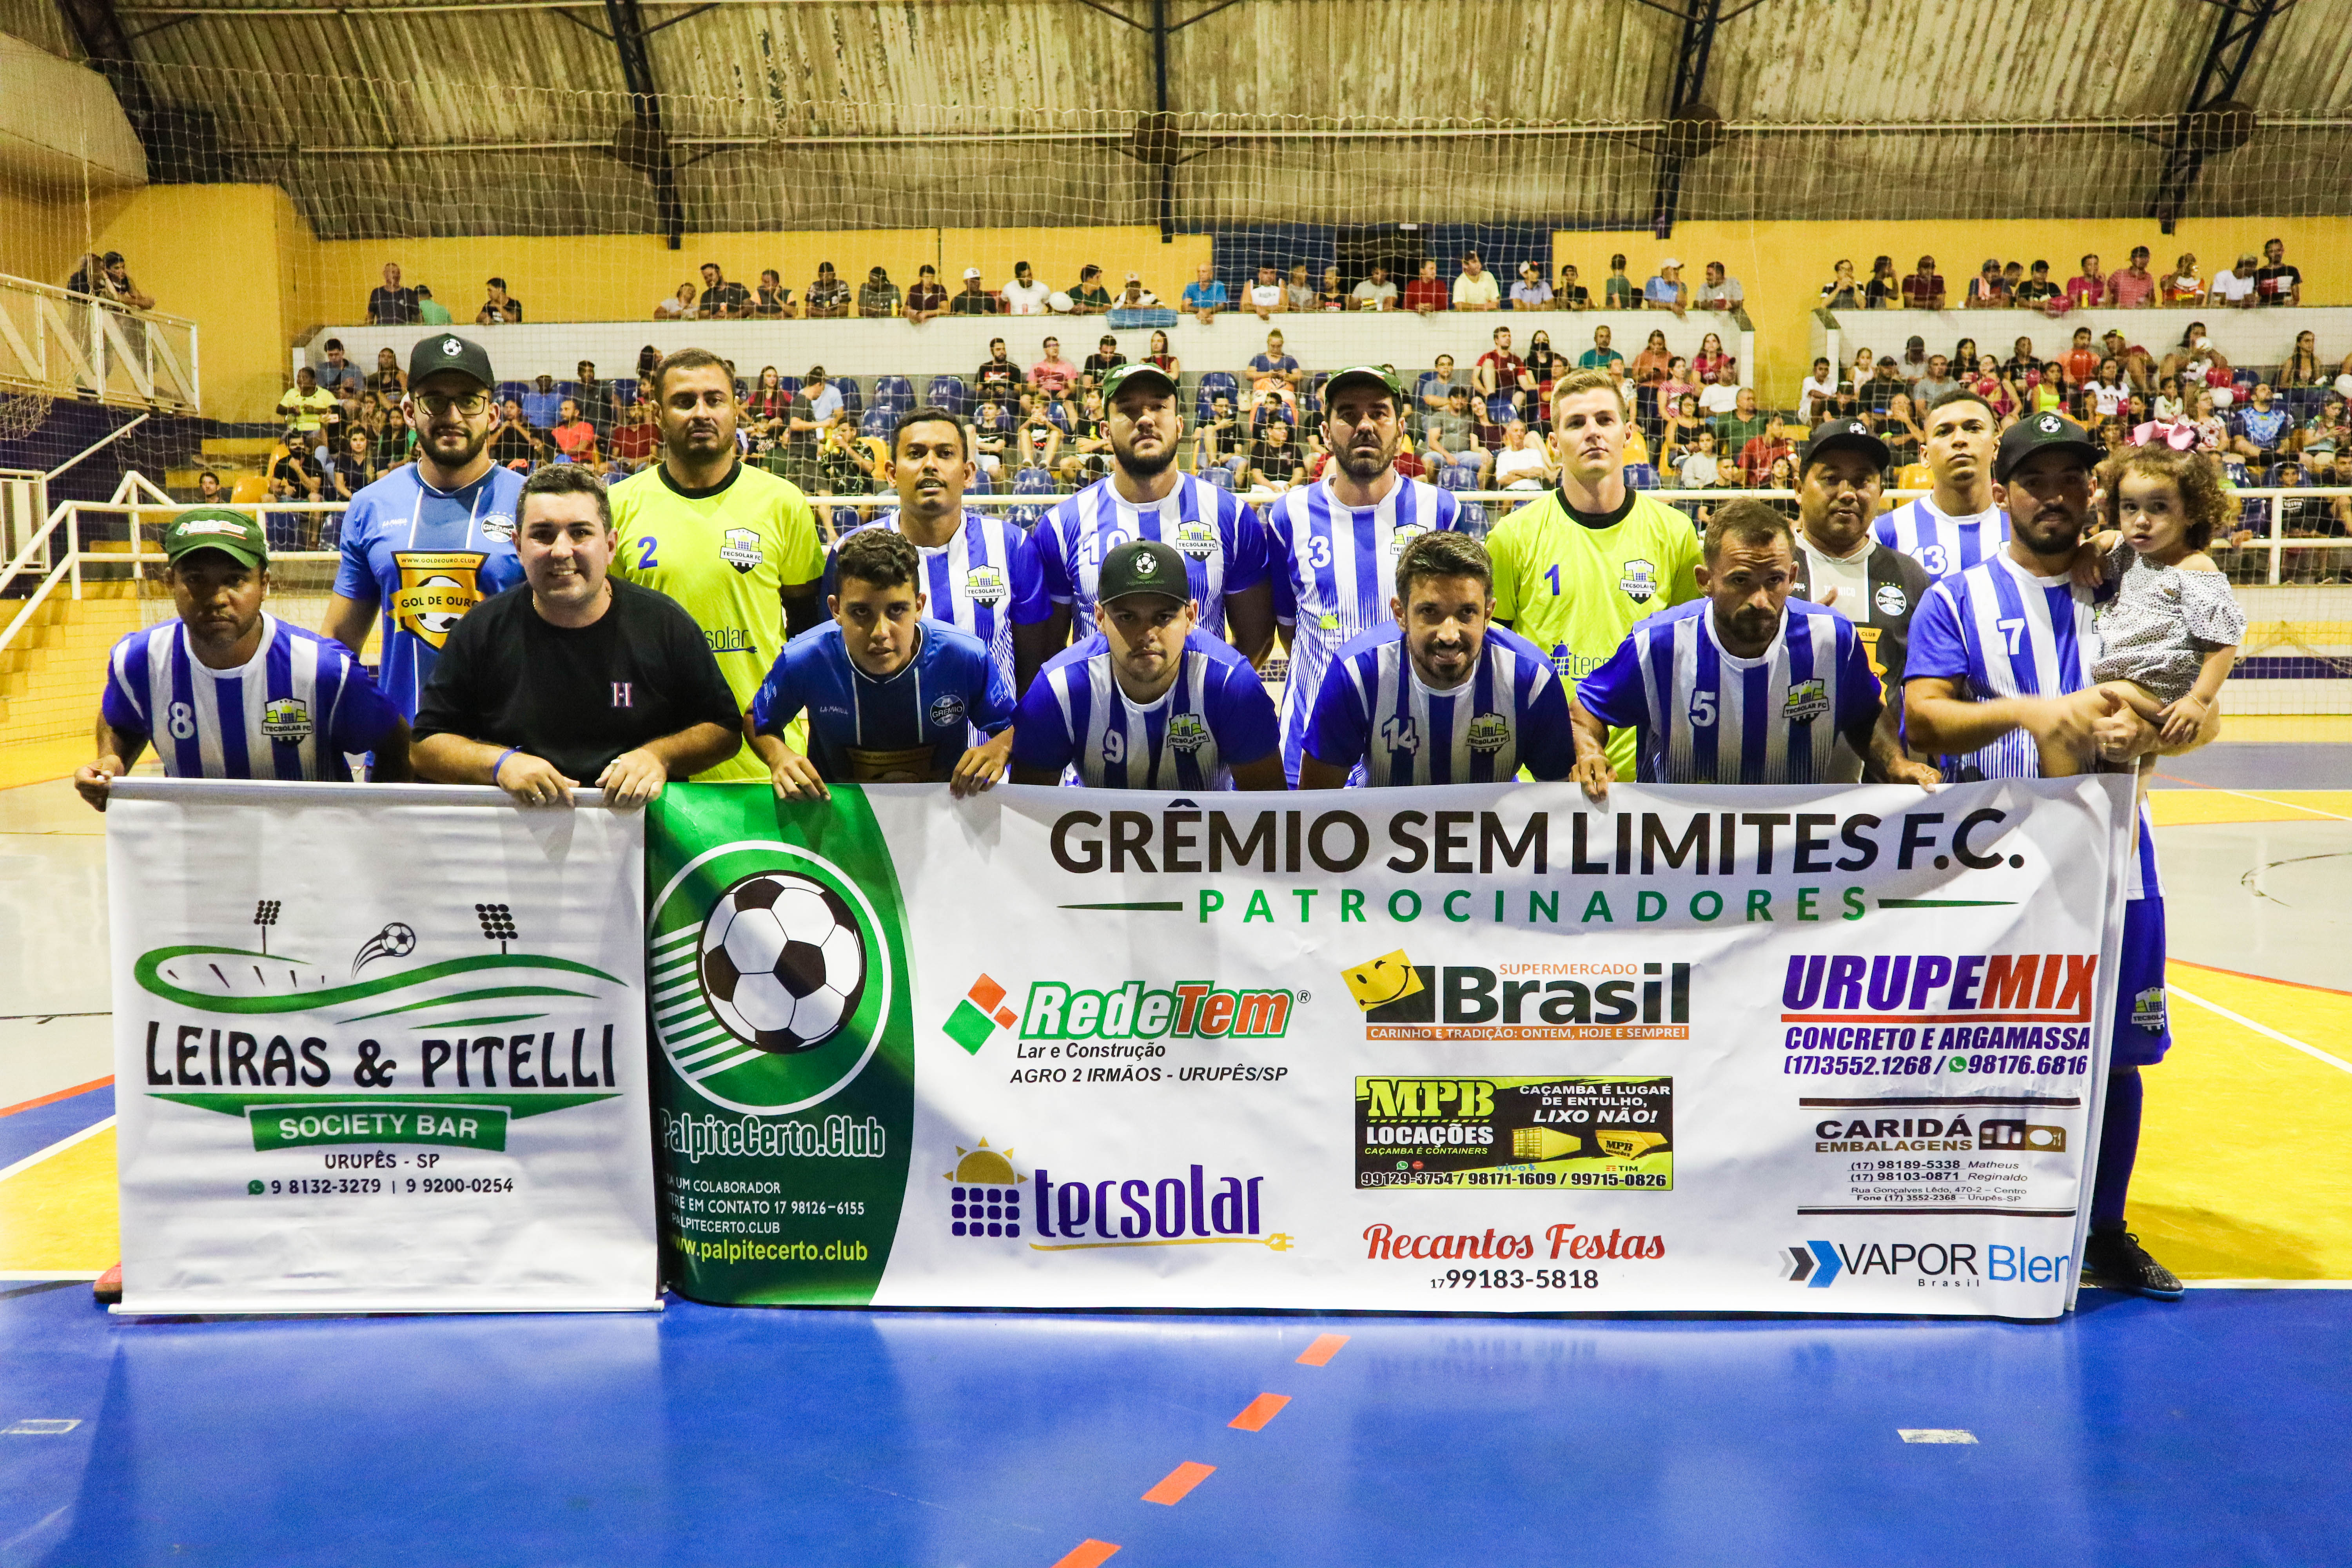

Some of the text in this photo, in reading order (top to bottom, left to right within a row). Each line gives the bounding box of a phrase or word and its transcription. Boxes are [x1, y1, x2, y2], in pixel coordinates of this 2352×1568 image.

[637, 536, 658, 570] 2
[1308, 535, 1332, 568] 3
[1907, 545, 1948, 575] 13
[1544, 564, 1561, 596] 1
[1824, 584, 1856, 597] TNICO
[401, 597, 424, 608] GOL
[428, 596, 442, 605] DE
[704, 626, 749, 649] solar
[1997, 618, 2025, 655] 7
[1690, 688, 1717, 727] 5
[1786, 703, 1816, 715] TECSOLAR
[167, 701, 195, 740] 8
[1381, 714, 1420, 754] 14
[1104, 728, 1125, 764] 9
[1050, 798, 2025, 876] GRÊMIO SEM LIMITES F.C.
[1199, 886, 1866, 924] PATROCINADORES
[1499, 963, 1638, 975] SUPERMERCADO
[1443, 962, 1690, 1024] Brasil
[1782, 954, 2099, 1011] URUPEMIX
[1019, 980, 1294, 1040] RedeTem
[2133, 1013, 2164, 1022] TECSOLA
[1370, 1026, 1685, 1041] CARINHO E TRADIÇÃO: ONTEM, HOJE E SEMPRE!
[1785, 1026, 2091, 1051] CONCRETO E ARGAMASSA
[146, 1021, 615, 1087] LEIRAS & PITELLI
[1017, 1041, 1166, 1061] Lar e Construção
[1010, 1068, 1067, 1083] AGRO
[1072, 1068, 1082, 1082] 2
[1087, 1064, 1162, 1082] IRMÃOS
[1179, 1063, 1289, 1082] URUPÊS/SP
[1784, 1055, 1931, 1075] (17)3552.1268
[1967, 1054, 2087, 1075] 98176.6816
[1368, 1080, 1497, 1117] MPB
[1519, 1082, 1671, 1097] CAÇAMBA É LUGAR
[1542, 1096, 1648, 1107] DE ENTULHO,
[1533, 1106, 1658, 1123] LIXO NÃO!
[279, 1114, 478, 1140] SOCIETY BAR
[660, 1108, 885, 1163] PalpiteCerto.Club
[1366, 1123, 1494, 1148] LOCAÇÕES
[1815, 1114, 1973, 1140] CARIDÁ
[1365, 1147, 1414, 1157] CAÇAMBA
[1416, 1145, 1423, 1154] É
[1606, 1140, 1633, 1151] MPB
[1815, 1140, 1973, 1153] EMBALAGENS
[324, 1150, 397, 1169] URUPÊS
[417, 1154, 440, 1169] SP
[1496, 1163, 1526, 1172] vivo
[1851, 1160, 2019, 1171] (17) 98189-5338 Matheus
[271, 1179, 281, 1194] 9
[289, 1178, 381, 1194] 8132-3279
[406, 1178, 416, 1193] 9
[423, 1178, 514, 1193] 9200-0254
[676, 1176, 690, 1191] UM
[693, 1180, 780, 1194] COLABORADOR
[1361, 1172, 1455, 1186] 99129-3754
[1468, 1172, 1556, 1186] 98171-1609
[1571, 1173, 1667, 1187] 99715-0826
[1851, 1172, 2028, 1182] (17) 98103-0871 Reginaldo
[1035, 1164, 1264, 1239] tecsolar
[1873, 1187, 1924, 1195] Gonçalves
[1967, 1194, 2022, 1202] Urupês-SP
[688, 1198, 704, 1212] EM
[708, 1200, 769, 1214] CONTATO
[774, 1201, 786, 1214] 17
[791, 1201, 865, 1216] 98126-6155
[1362, 1223, 1665, 1259] Recantos Festas
[1839, 1243, 2070, 1284] VAPOR Blen
[1918, 1278, 1980, 1287] Brasil
